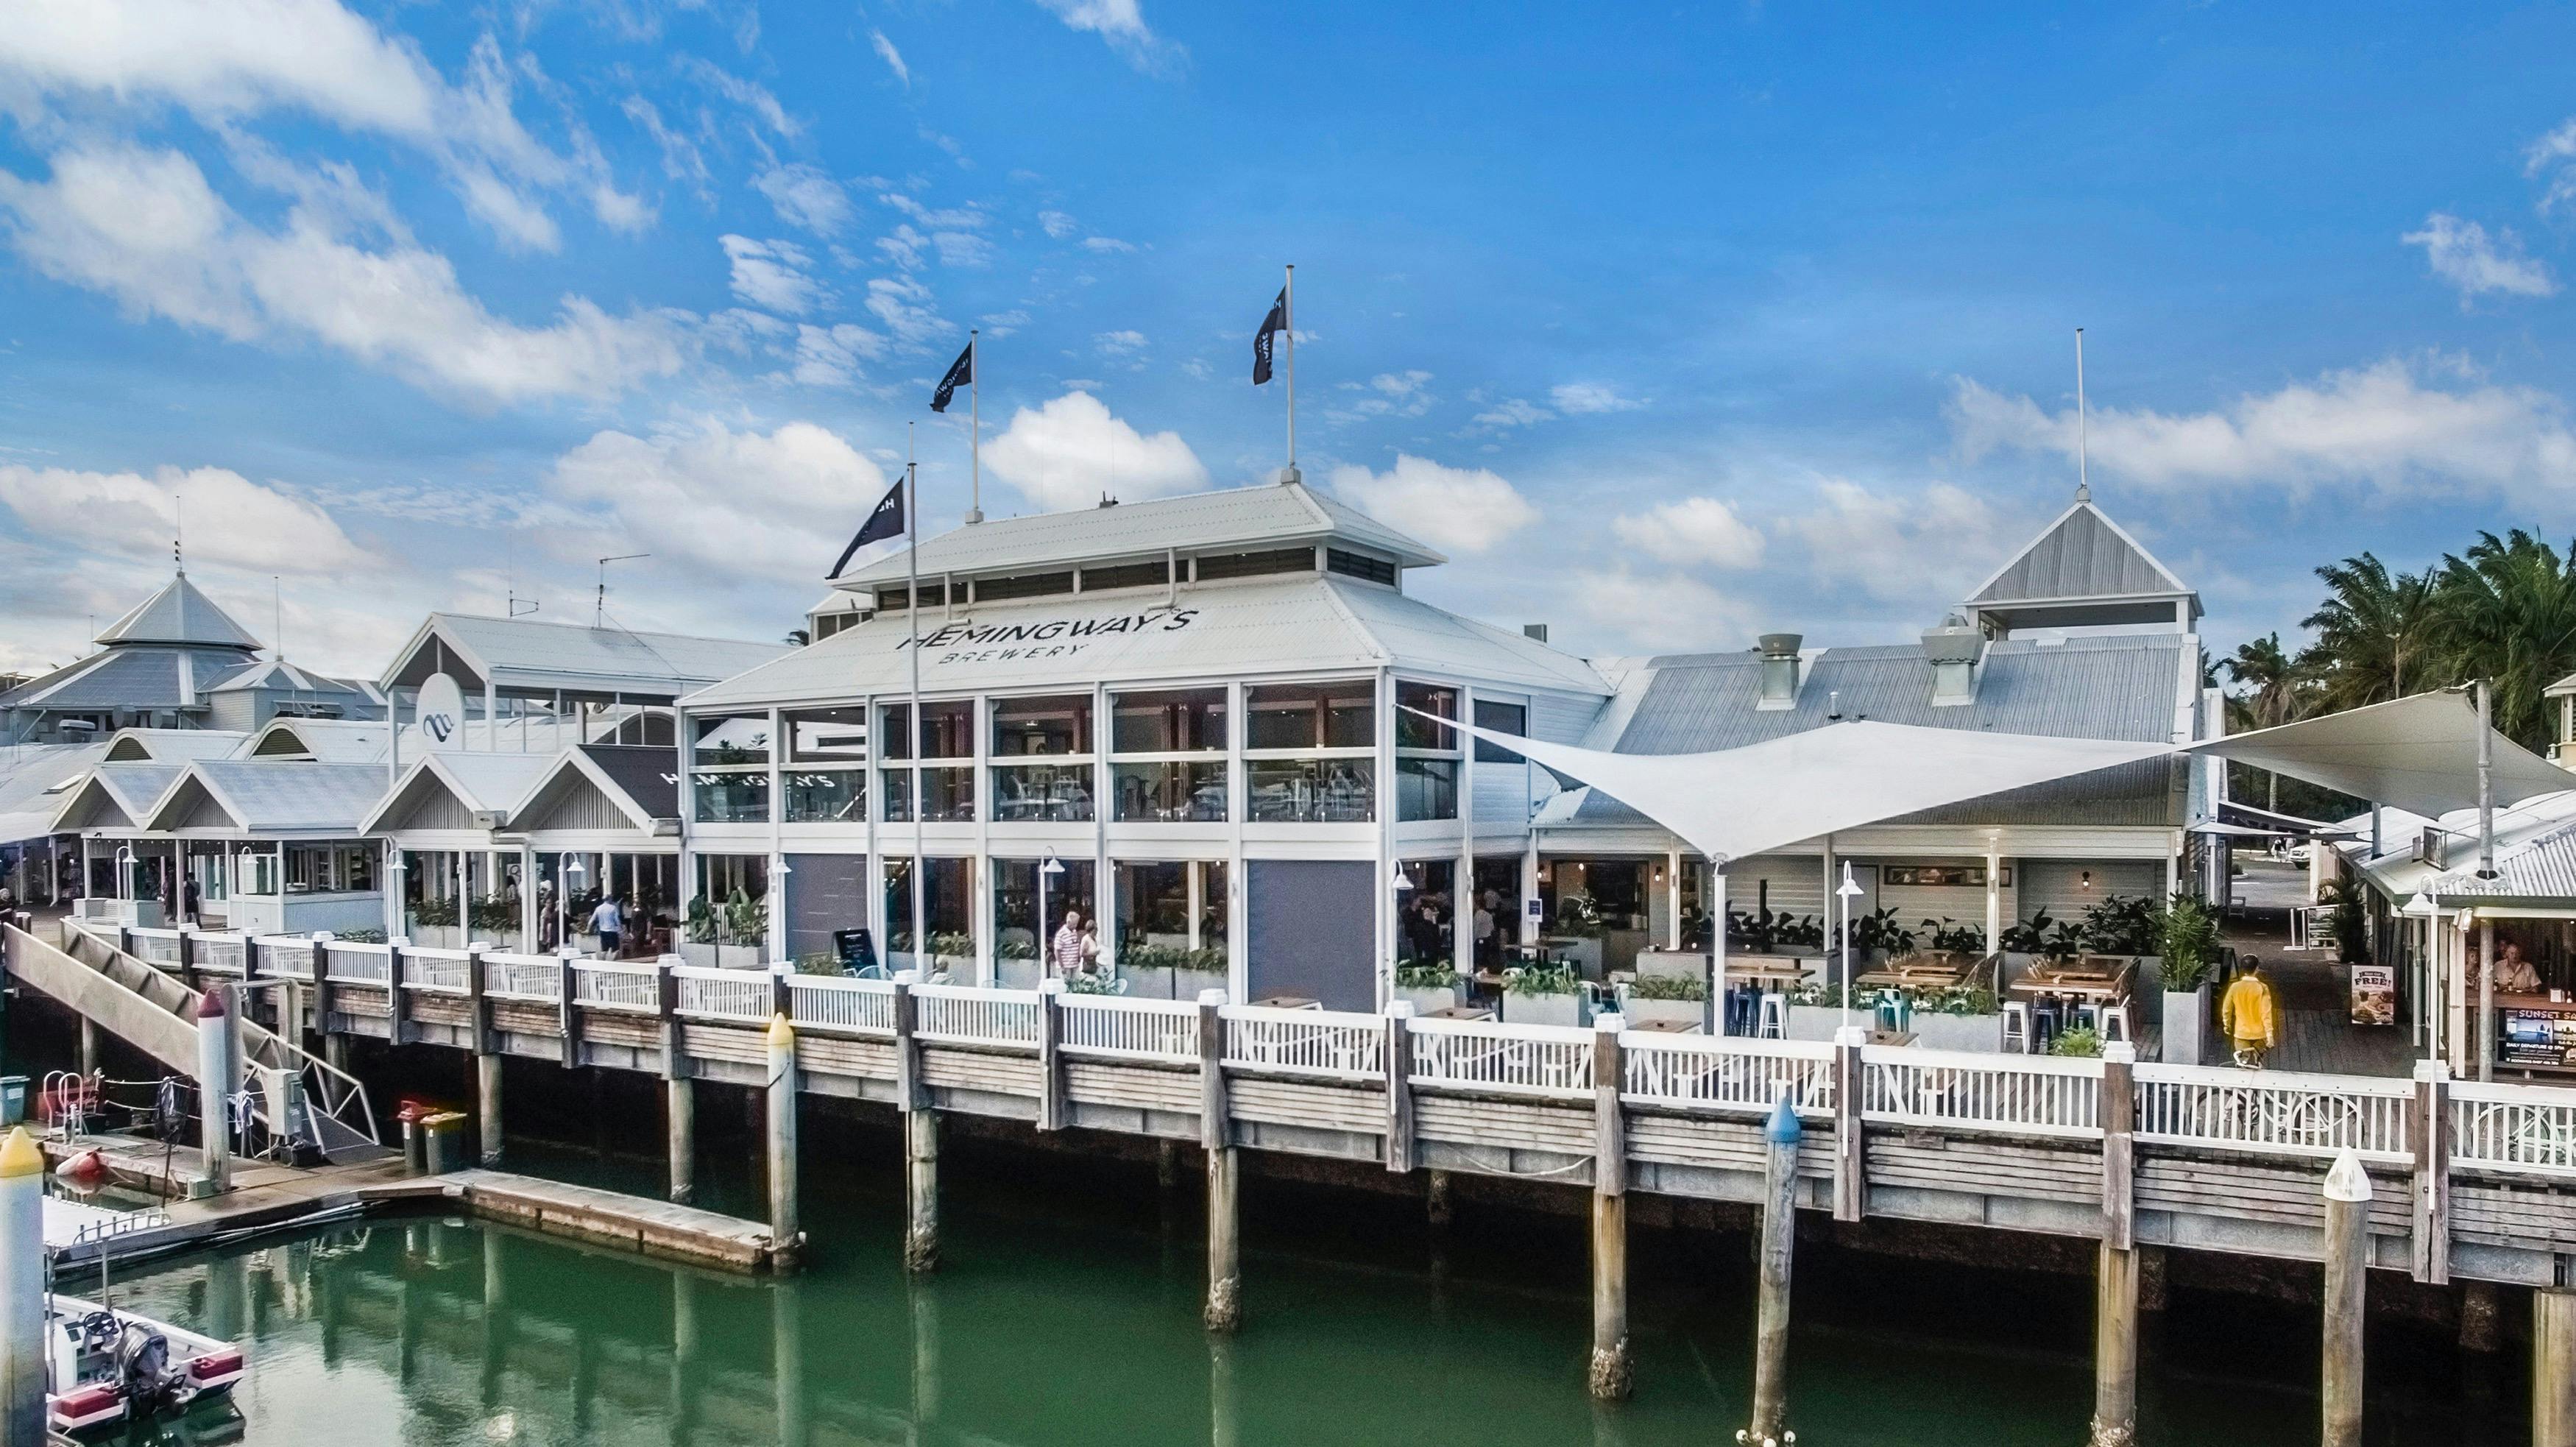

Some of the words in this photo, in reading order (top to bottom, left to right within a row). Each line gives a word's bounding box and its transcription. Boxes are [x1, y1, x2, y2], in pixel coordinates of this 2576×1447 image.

[896, 609, 1199, 650] HEMINGWAY'S
[938, 643, 1089, 664] BREWERY
[2354, 977, 2391, 987] FREE!
[2519, 1010, 2560, 1019] SUNSET
